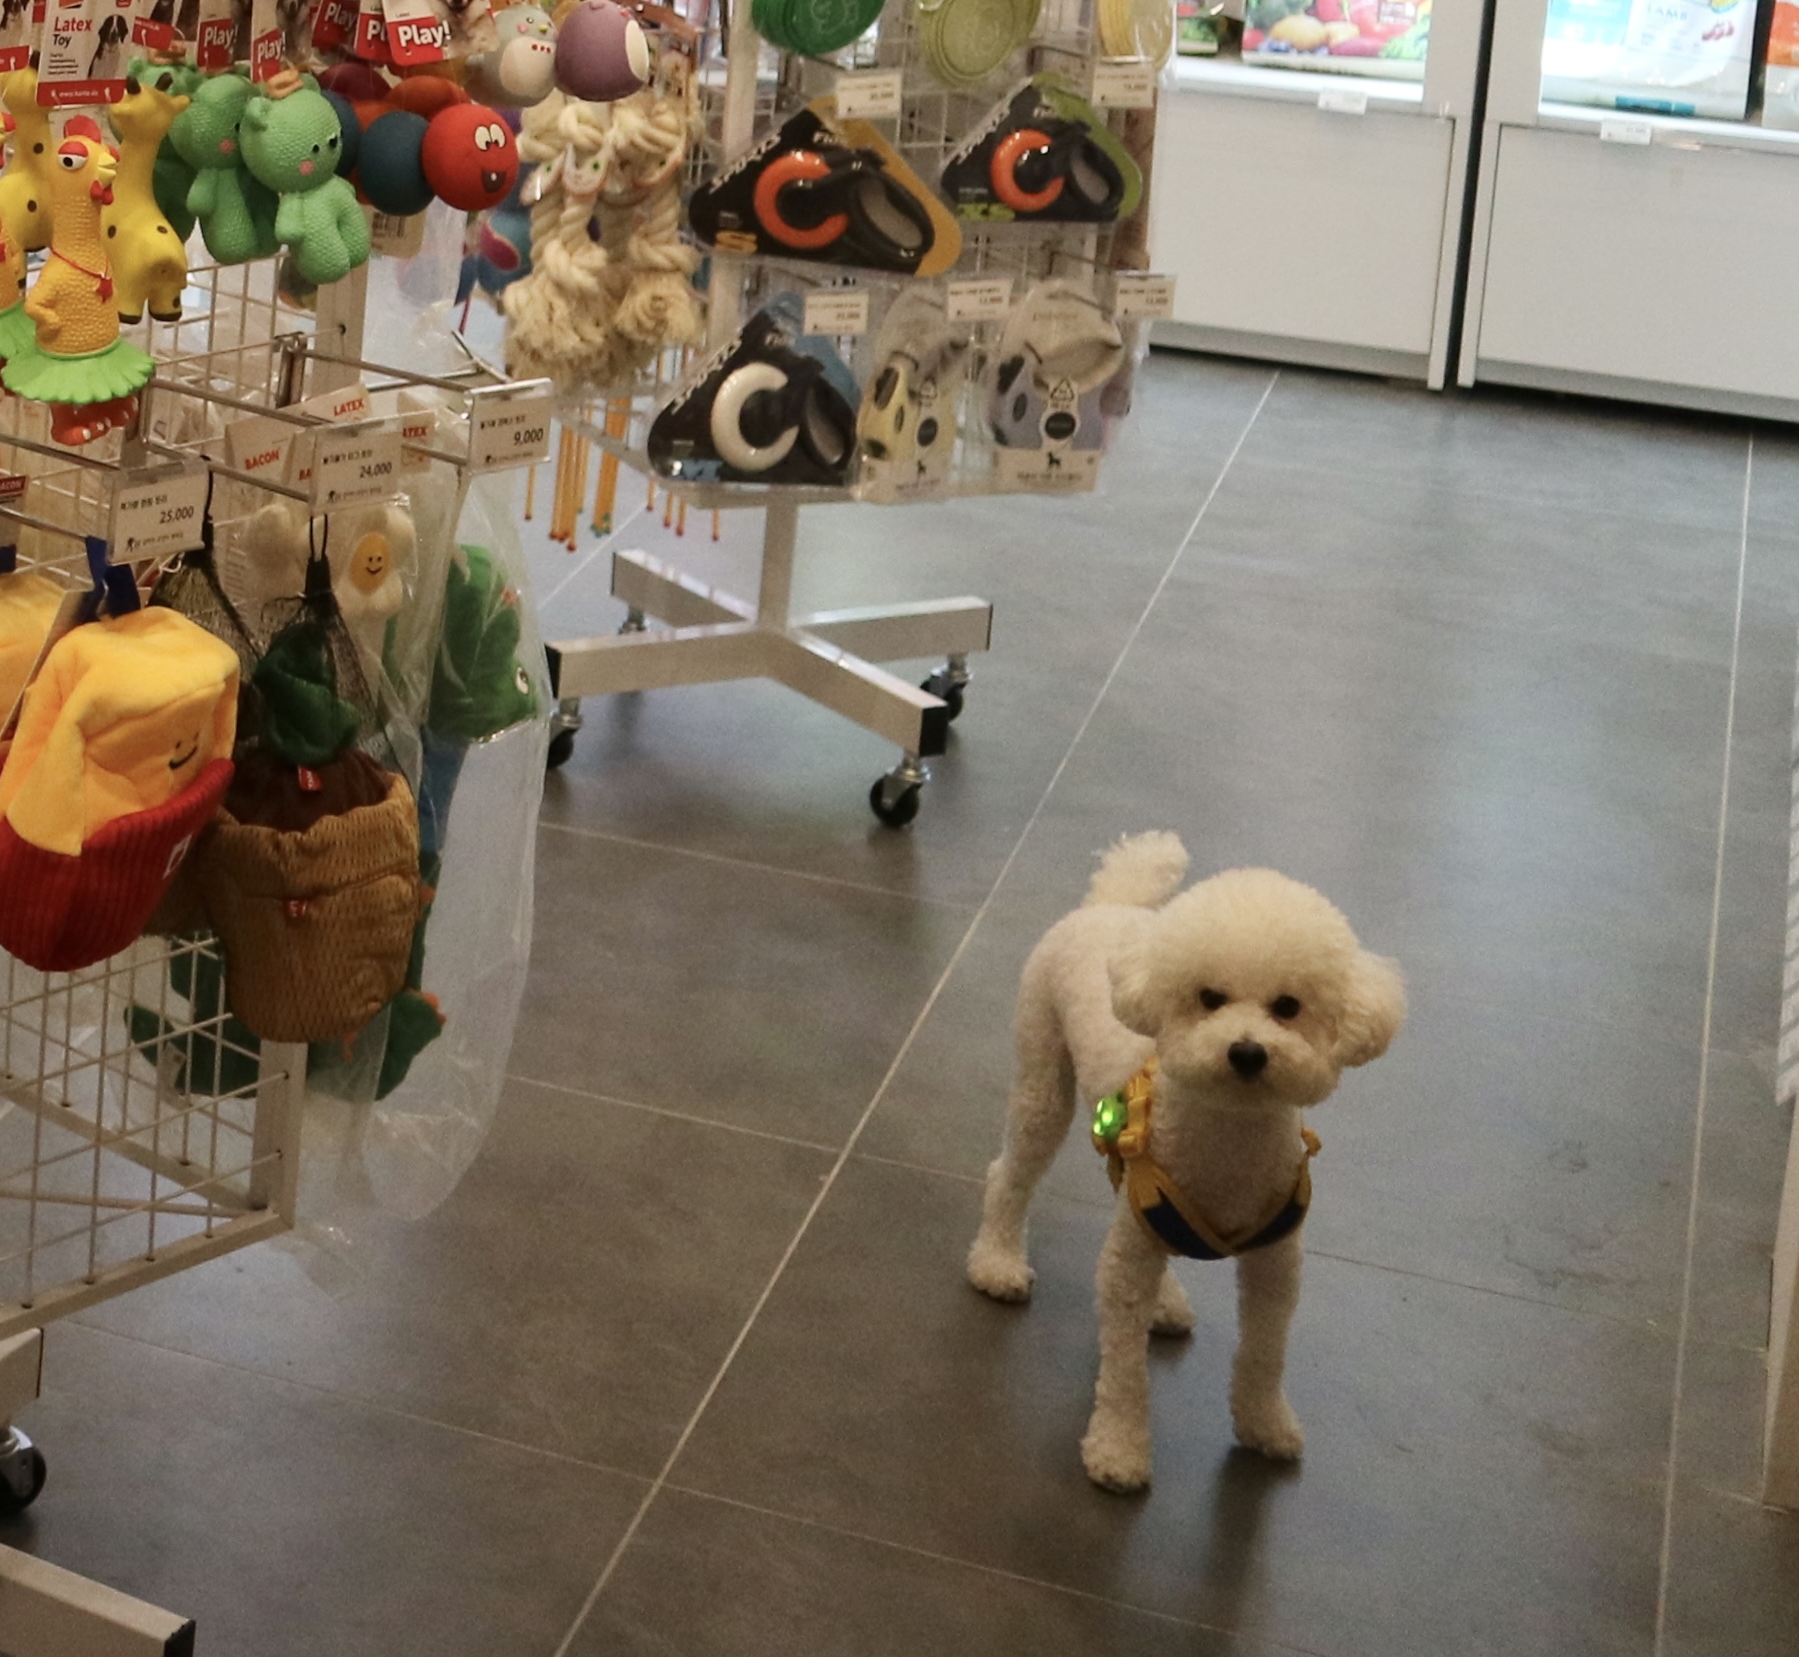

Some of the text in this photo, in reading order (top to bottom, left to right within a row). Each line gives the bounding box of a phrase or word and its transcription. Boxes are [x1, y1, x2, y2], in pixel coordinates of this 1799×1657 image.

[398, 21, 452, 47] Play!
[333, 398, 365, 417] LATEX
[513, 427, 544, 446] 9,000
[244, 450, 279, 471] BACON
[159, 505, 195, 525] 25,000
